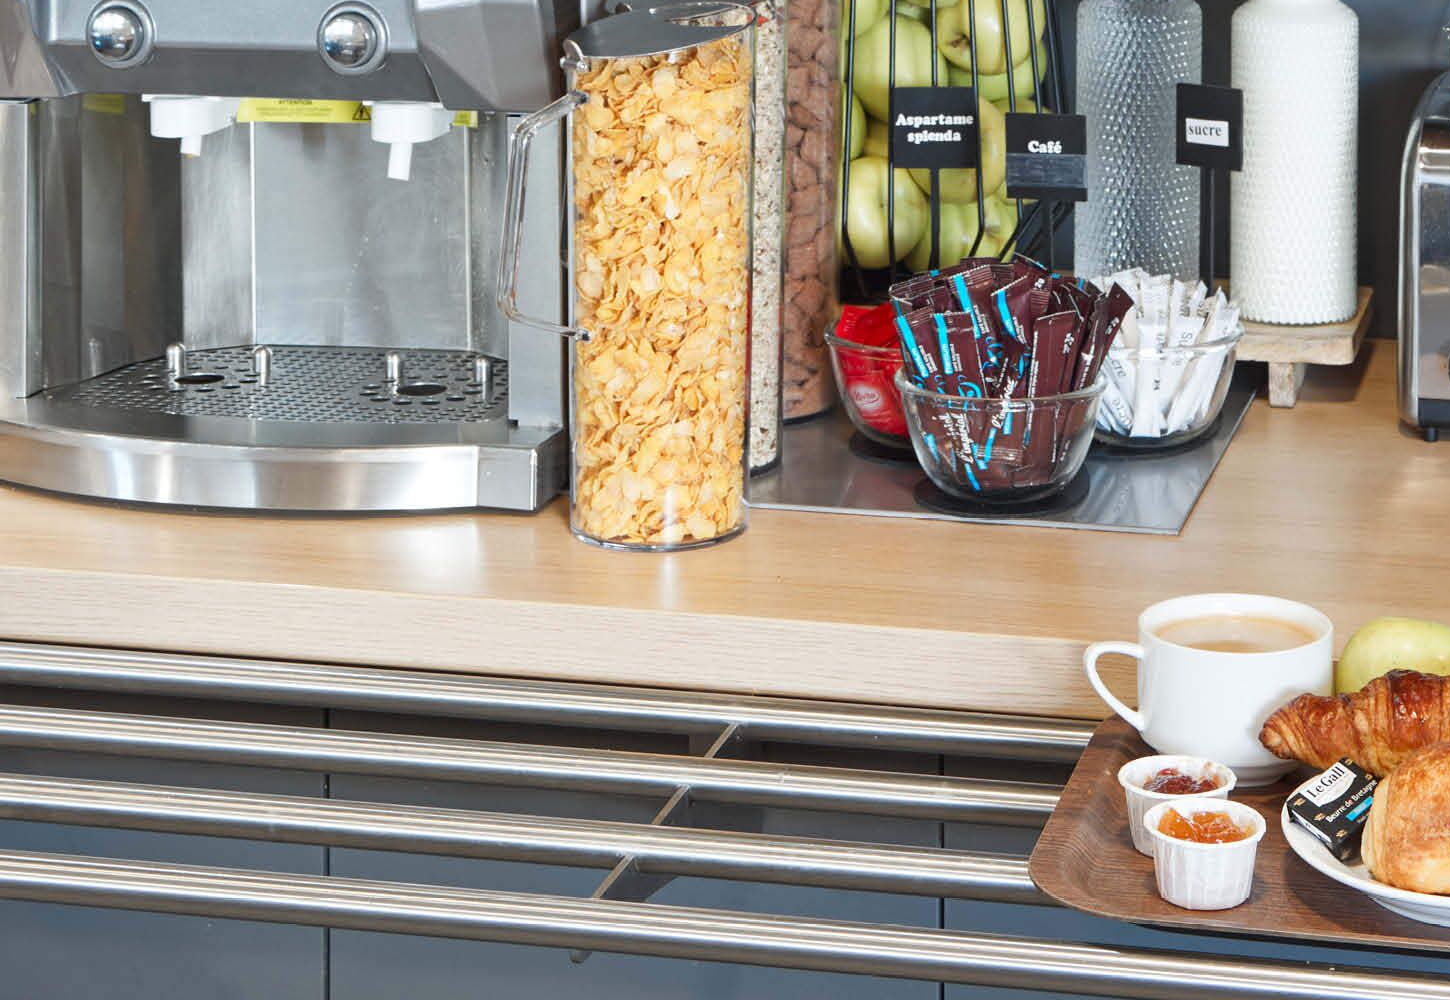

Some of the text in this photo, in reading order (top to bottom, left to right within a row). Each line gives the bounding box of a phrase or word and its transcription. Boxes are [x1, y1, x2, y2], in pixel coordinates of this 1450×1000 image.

[894, 113, 975, 128] Aspartame
[906, 129, 962, 145] splenda
[1187, 124, 1222, 137] sucre
[1027, 139, 1063, 154] Café
[1325, 806, 1346, 823] Beurre
[1344, 799, 1354, 808] de
[1351, 779, 1378, 801] Bretagne
